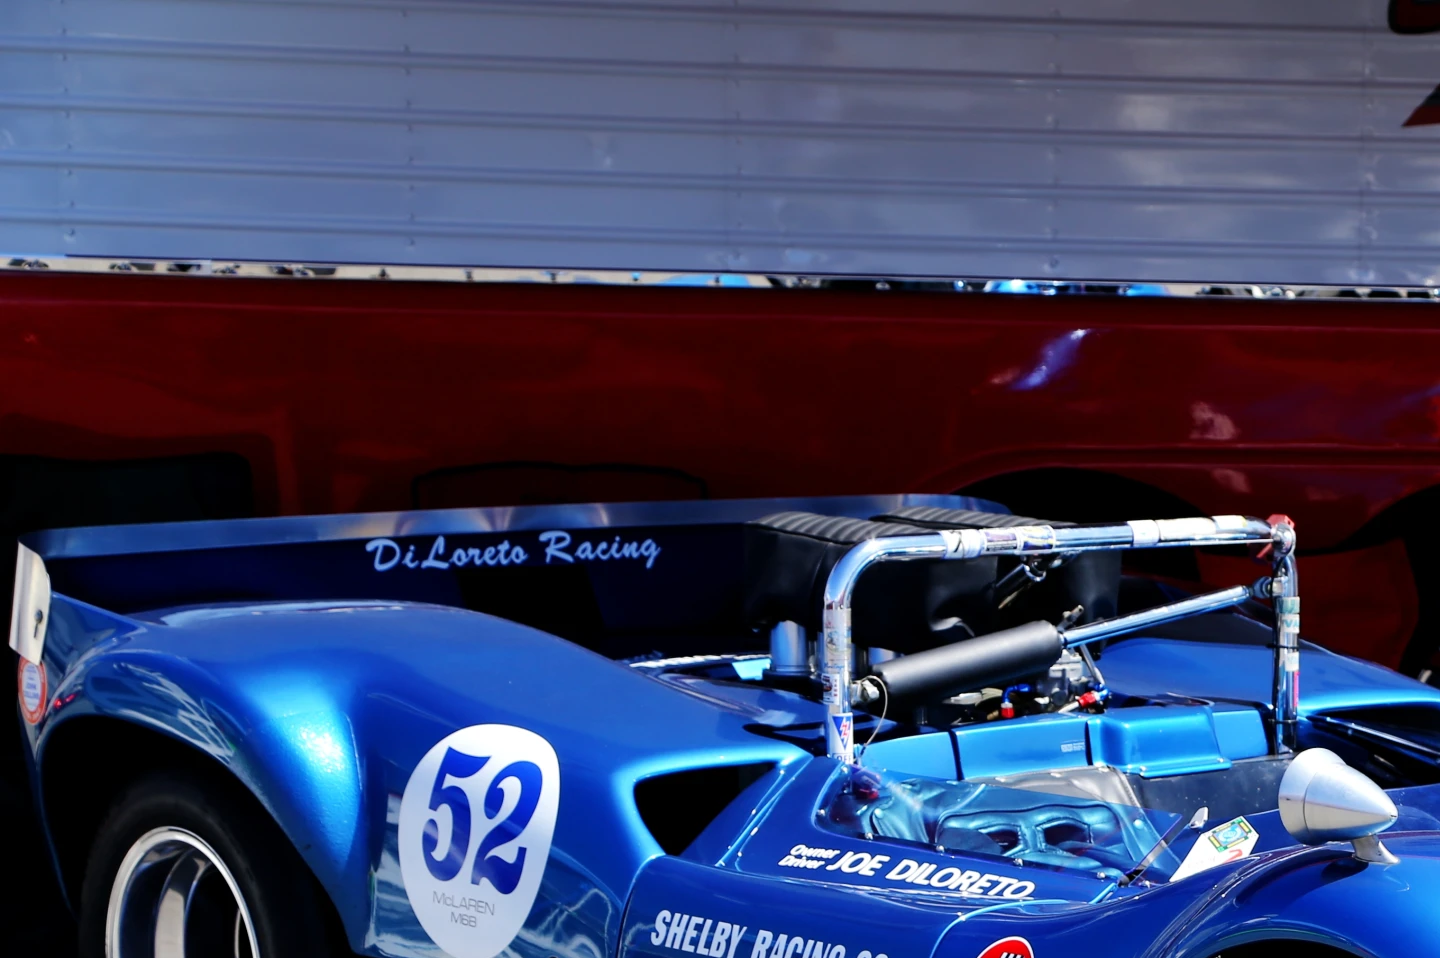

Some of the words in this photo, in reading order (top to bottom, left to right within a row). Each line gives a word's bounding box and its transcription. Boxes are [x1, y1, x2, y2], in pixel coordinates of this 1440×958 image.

[365, 535, 528, 571] DiLoreto
[538, 530, 661, 569] Racing
[422, 746, 543, 895] 52
[777, 854, 826, 869] Driver
[790, 844, 841, 859] Owner
[825, 851, 891, 877] JOE
[885, 858, 1037, 899] DILORETO
[432, 891, 495, 916] McLAREN
[450, 914, 477, 928] M6B
